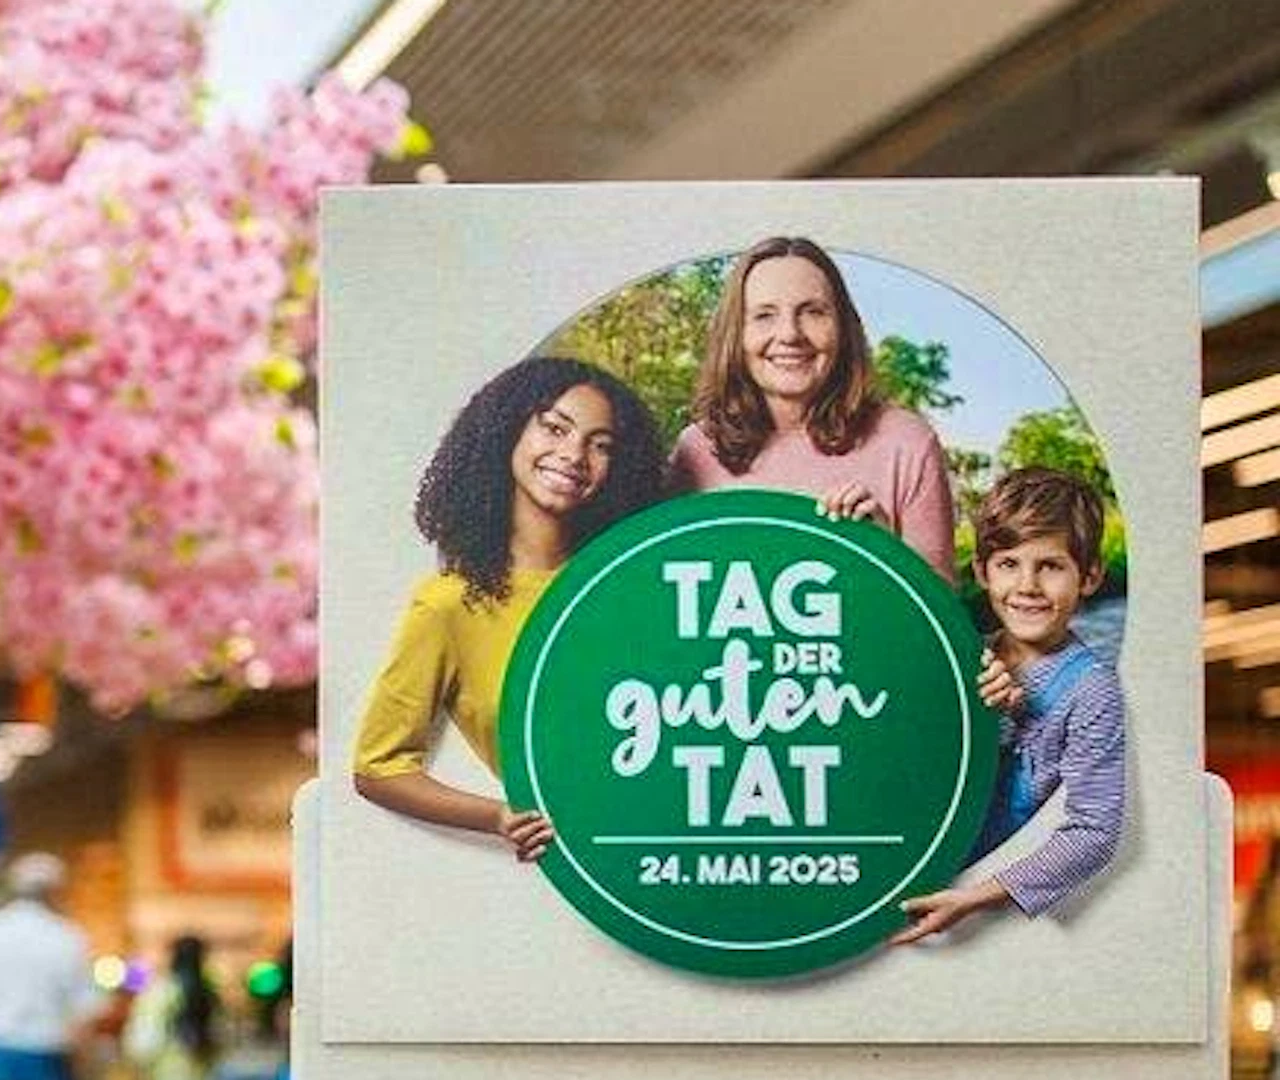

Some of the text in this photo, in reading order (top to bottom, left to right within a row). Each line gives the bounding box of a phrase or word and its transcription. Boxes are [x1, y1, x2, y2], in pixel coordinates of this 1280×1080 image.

[662, 560, 842, 638] TAG
[773, 642, 842, 675] DER
[605, 638, 888, 777] guten
[672, 744, 842, 827] TAT
[639, 853, 861, 885] 24. MAI 2025
